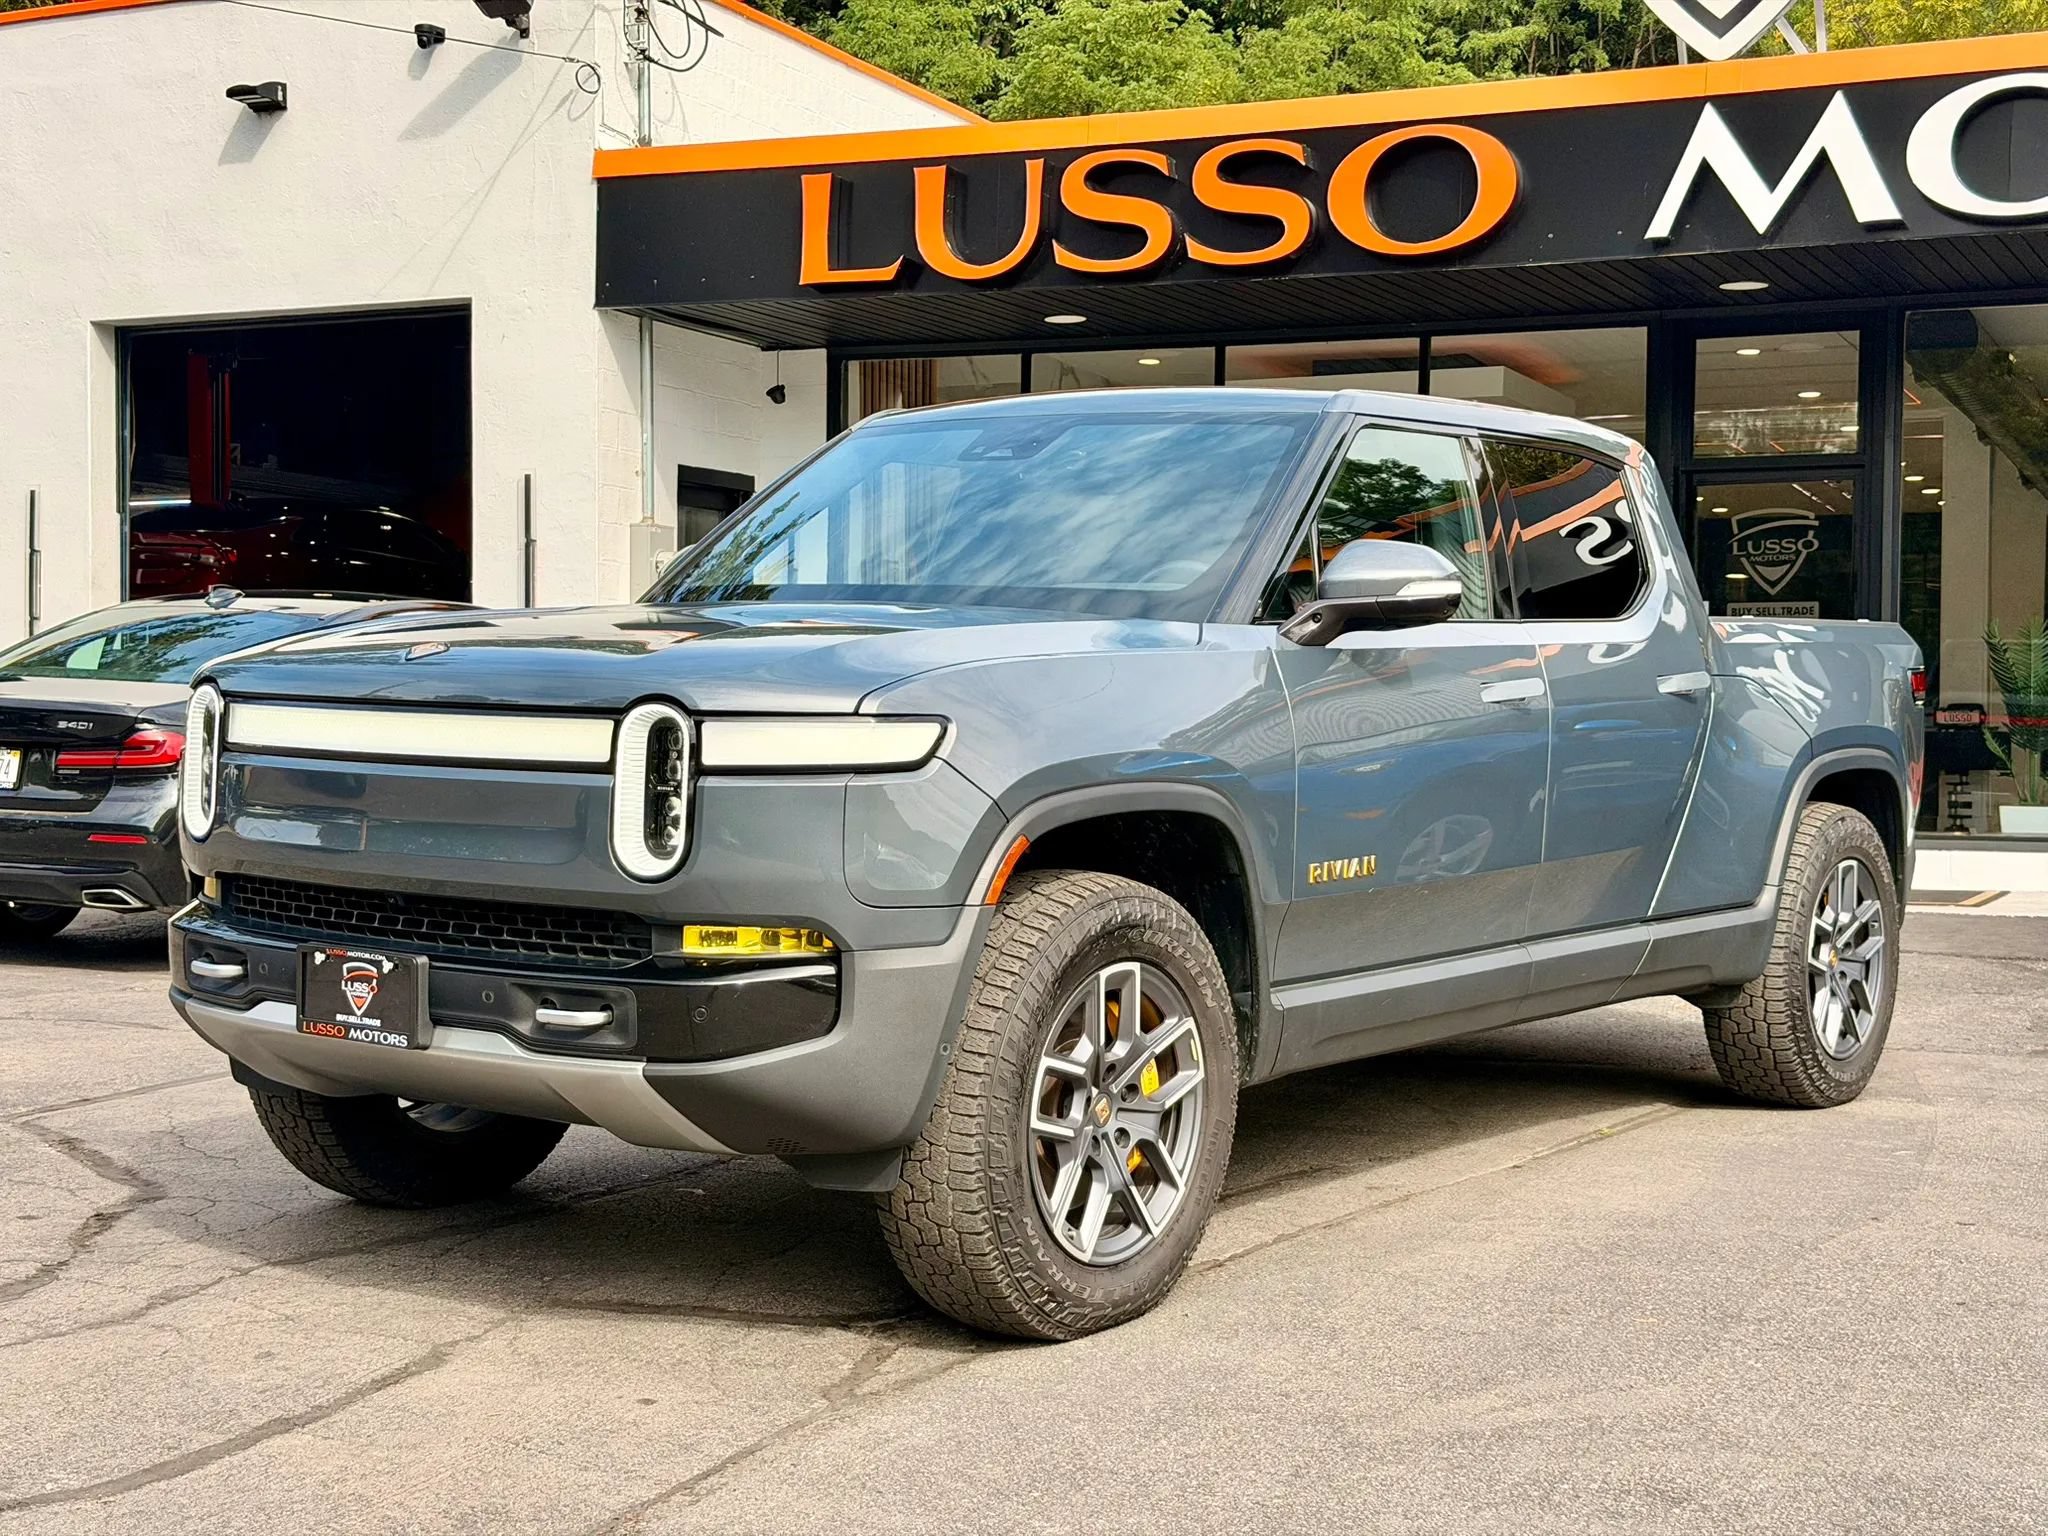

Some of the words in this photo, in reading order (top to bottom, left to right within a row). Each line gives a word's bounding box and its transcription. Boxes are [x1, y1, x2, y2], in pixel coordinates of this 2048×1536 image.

[799, 123, 1518, 286] LUSSO
[1643, 72, 2048, 241] MO
[1732, 537, 1820, 556] LUSSO
[1749, 554, 1796, 562] MOTORS
[1308, 854, 1377, 885] RIVIAN
[1113, 925, 1218, 1009] SCORPION
[341, 979, 378, 994] LUSSO
[303, 1021, 345, 1037] LUSSO
[348, 1028, 408, 1047] MOTORS
